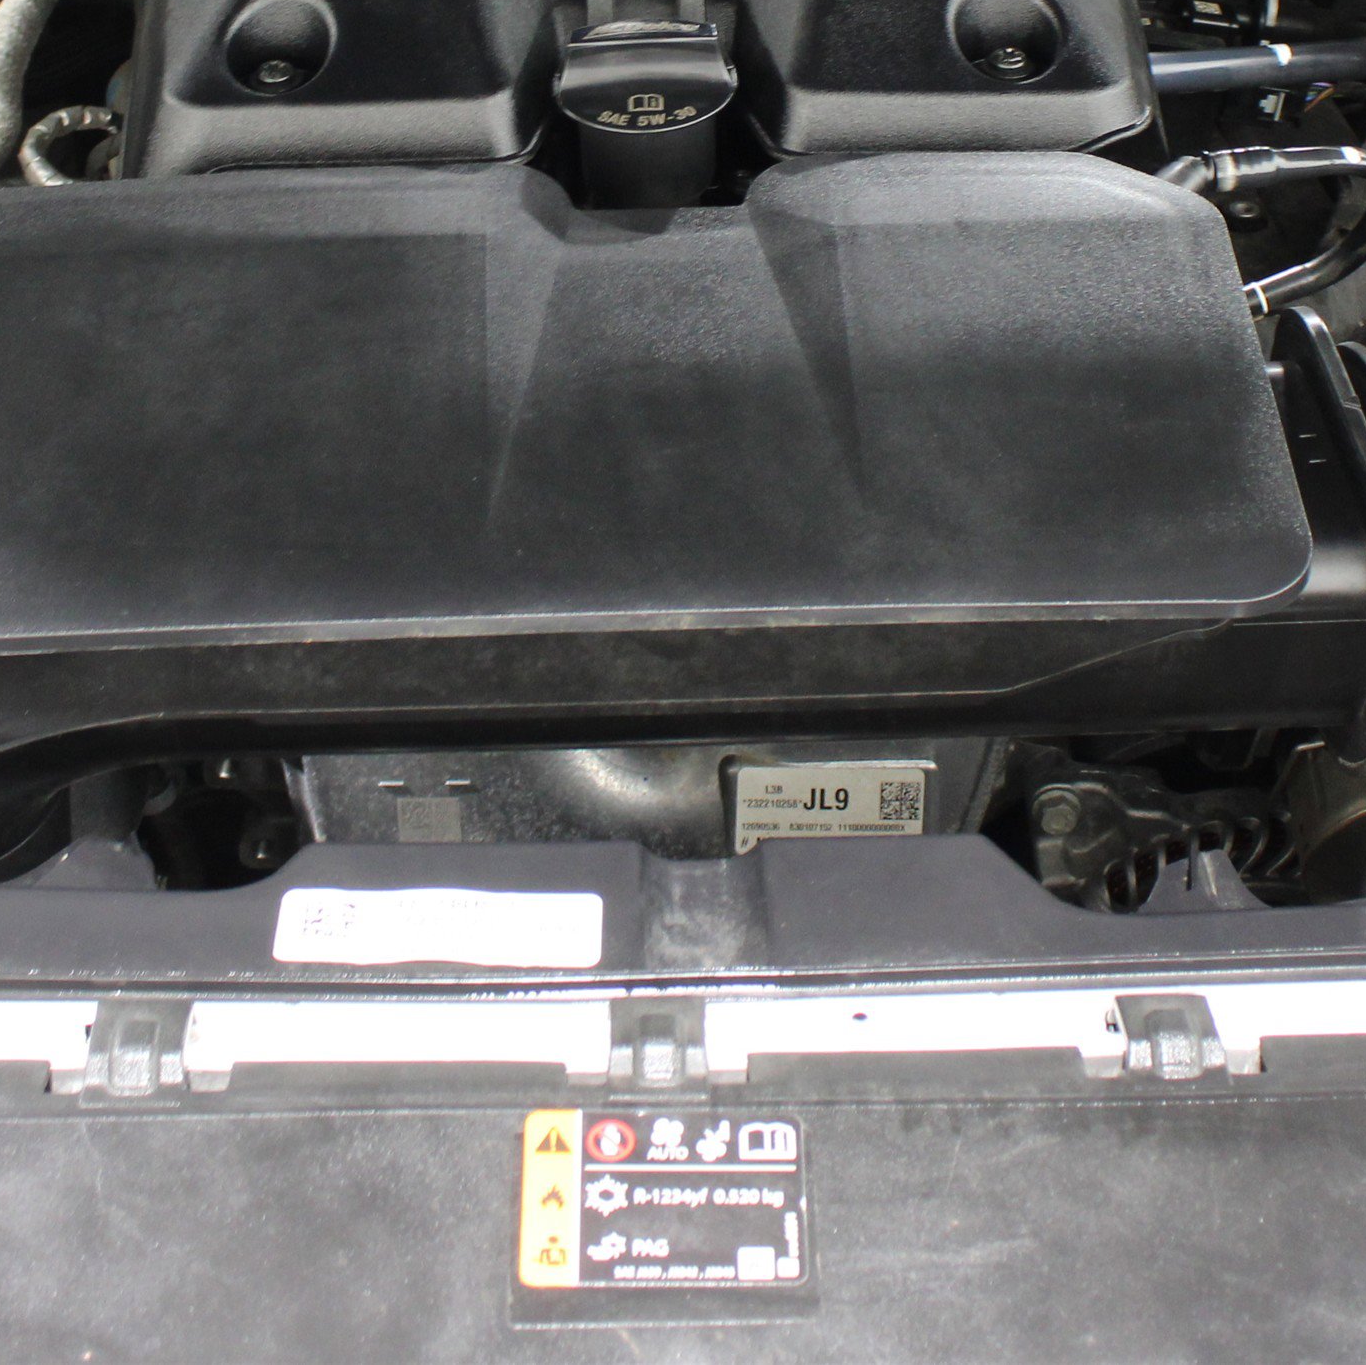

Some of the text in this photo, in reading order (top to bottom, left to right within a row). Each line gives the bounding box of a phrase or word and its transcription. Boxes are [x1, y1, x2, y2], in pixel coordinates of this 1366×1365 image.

[597, 105, 697, 127] SAE 5W-30
[803, 787, 849, 811] JL9
[647, 1146, 689, 1161] AUTO
[632, 1187, 707, 1208] R-1234yf
[762, 1187, 785, 1208] kg
[632, 1238, 670, 1258] PAG
